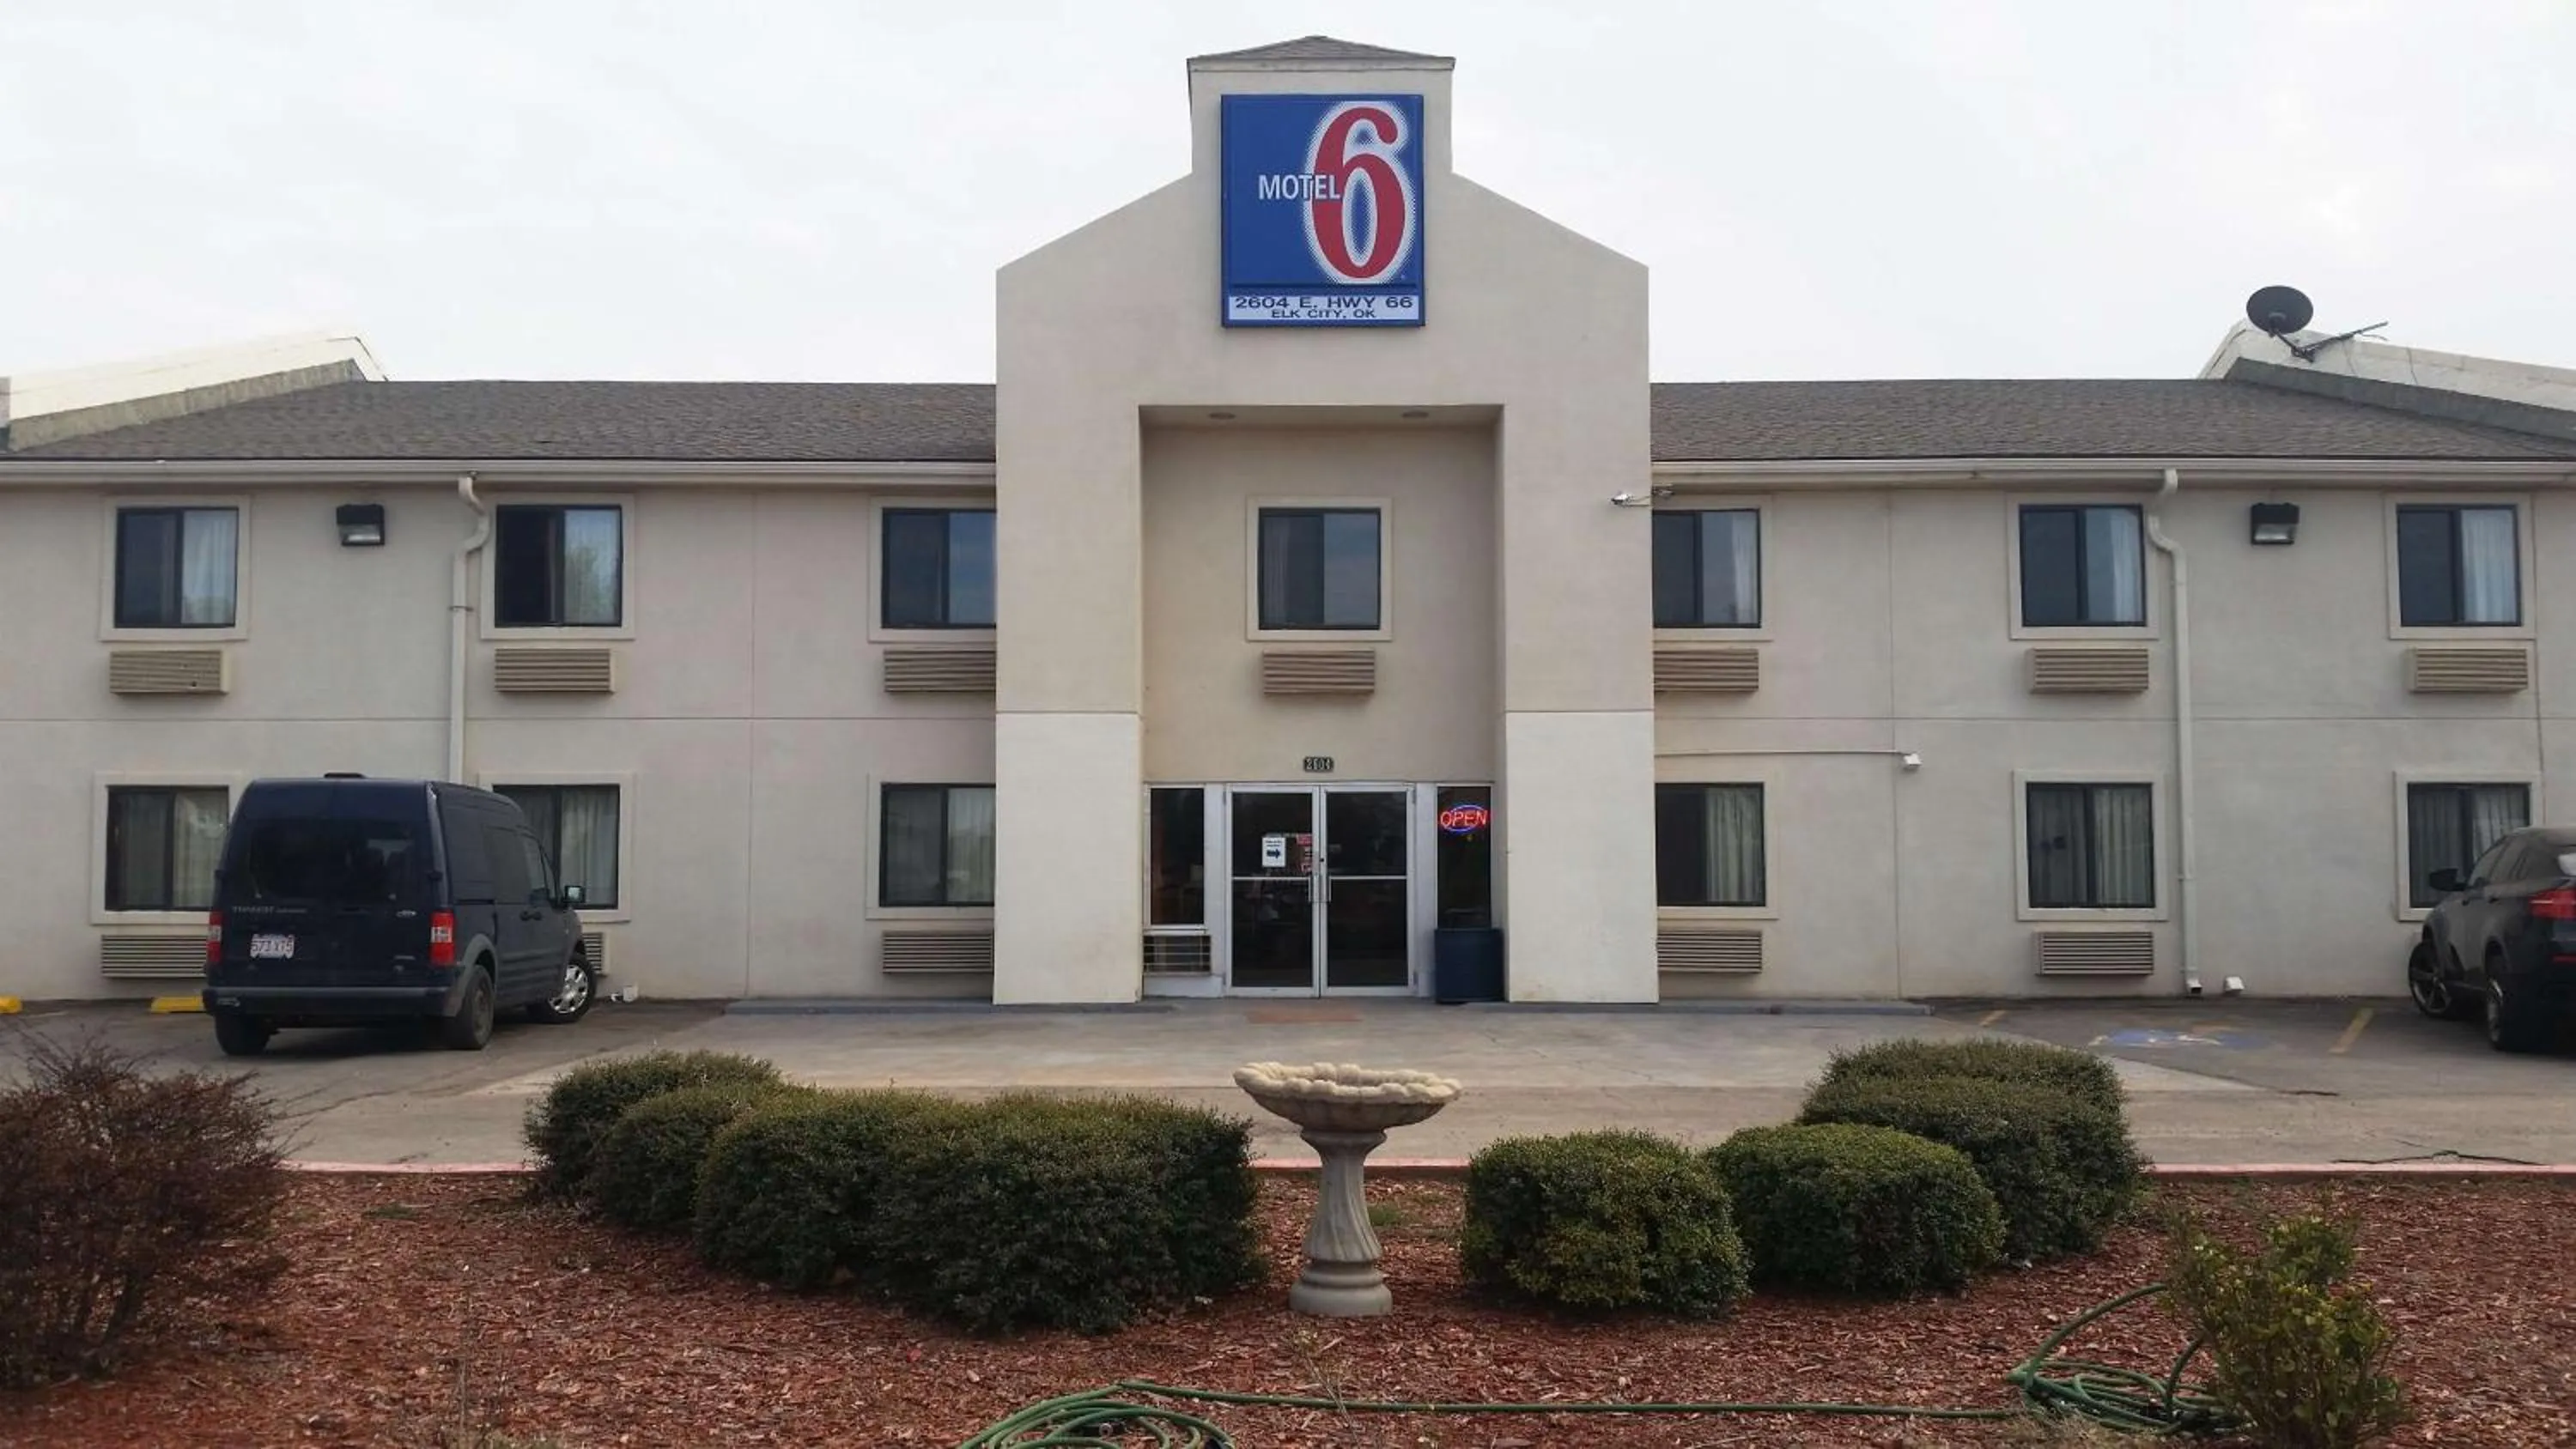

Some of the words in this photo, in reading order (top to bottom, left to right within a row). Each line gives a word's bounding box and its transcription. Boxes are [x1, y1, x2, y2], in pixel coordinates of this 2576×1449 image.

[1259, 174, 1341, 199] MOTEL
[1310, 105, 1406, 280] 6
[1235, 297, 1289, 308] 2604
[1299, 297, 1317, 308] E.
[1327, 297, 1376, 308] HWY
[1385, 297, 1414, 308] 66
[1271, 309, 1301, 318] ELK
[1352, 309, 1376, 318] OK
[1440, 809, 1488, 829] OPEN
